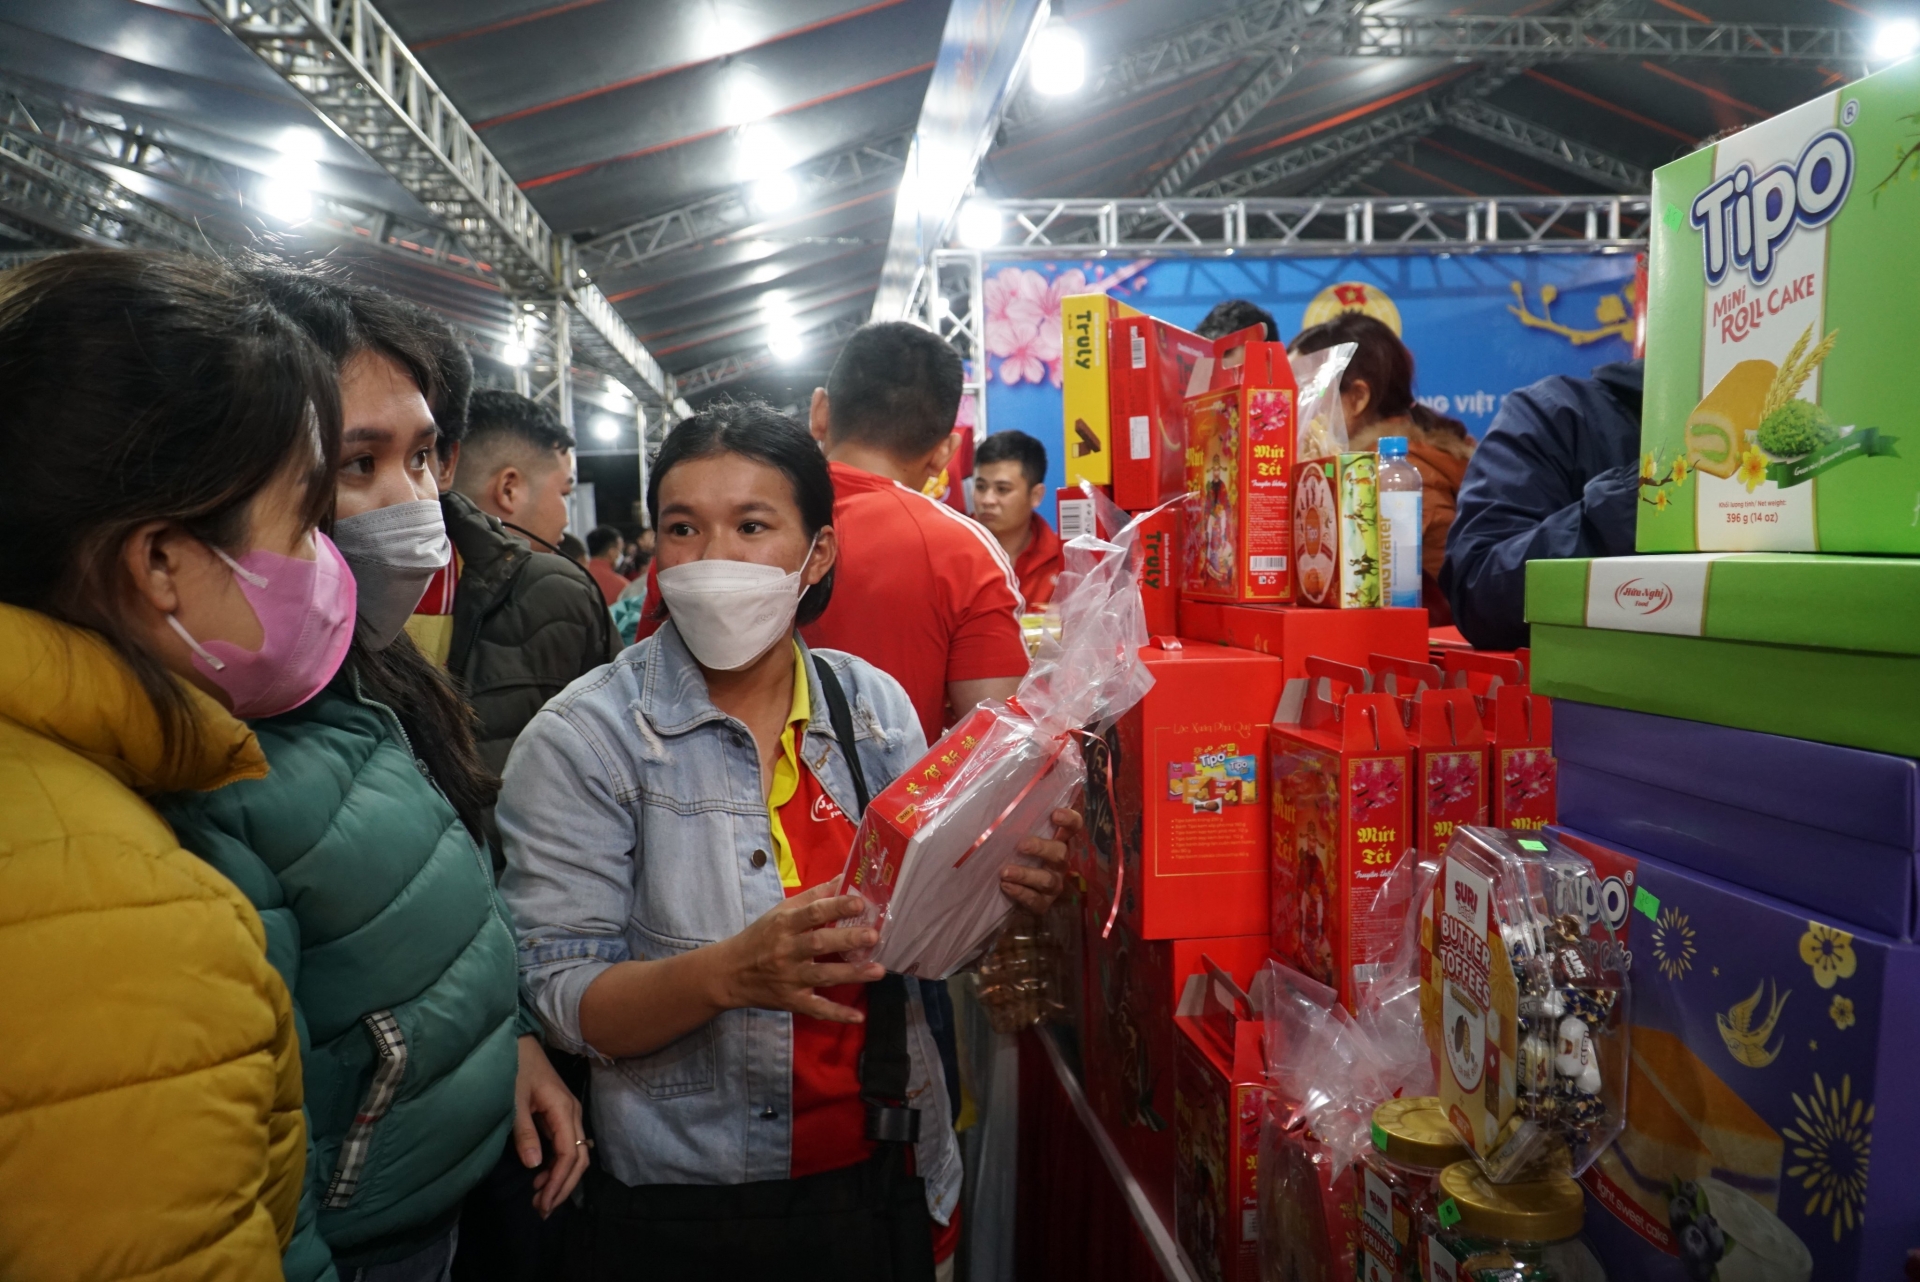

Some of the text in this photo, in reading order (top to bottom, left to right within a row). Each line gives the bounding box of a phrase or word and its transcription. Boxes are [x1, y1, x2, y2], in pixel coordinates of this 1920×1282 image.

[1690, 129, 1854, 286] Tipo
[1722, 273, 1815, 344] ROLL CAKE
[1075, 310, 1092, 370] Truly
[1454, 389, 1495, 418] VIỆT
[1257, 459, 1282, 476] Tết
[1726, 512, 1779, 525] 396 g (14 oz)
[1145, 531, 1162, 590] Truly
[1634, 600, 1649, 608] Food
[1641, 587, 1664, 601] Nghị
[1199, 752, 1226, 768] Tipo
[1229, 761, 1248, 771] Tipo
[1356, 825, 1396, 843] Mứt
[1362, 843, 1392, 865] Tết
[1455, 880, 1479, 914] SURI
[1441, 911, 1491, 977] BUTTER
[1440, 945, 1491, 1013] TOFFEES
[1565, 949, 1587, 979] SURI
[365, 1017, 392, 1057] BURBERRY
[1369, 1189, 1388, 1215] SURI
[1363, 1212, 1395, 1249] MIXED
[1615, 1199, 1645, 1231] sweet
[1645, 1222, 1670, 1246] cake
[1363, 1230, 1395, 1268] FRUITS
